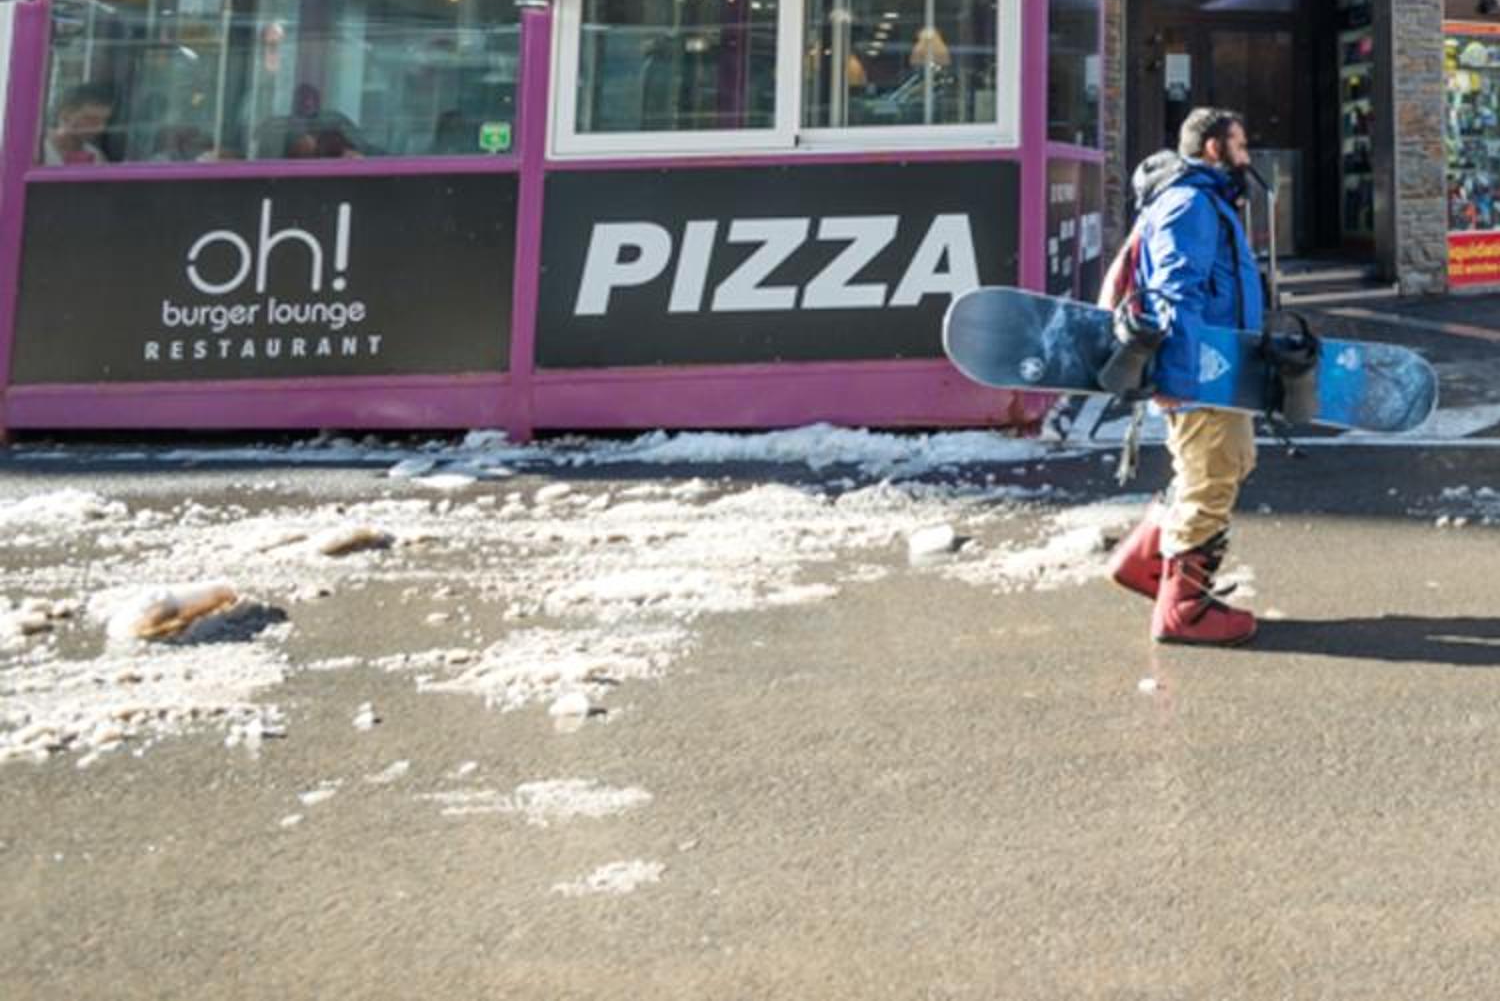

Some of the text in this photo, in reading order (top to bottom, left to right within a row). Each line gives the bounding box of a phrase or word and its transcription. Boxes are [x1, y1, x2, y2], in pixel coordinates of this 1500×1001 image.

[185, 198, 353, 294] oh!
[573, 213, 981, 317] PIZZA
[161, 296, 366, 333] burger lounge
[144, 335, 385, 361] RESTAURANT
